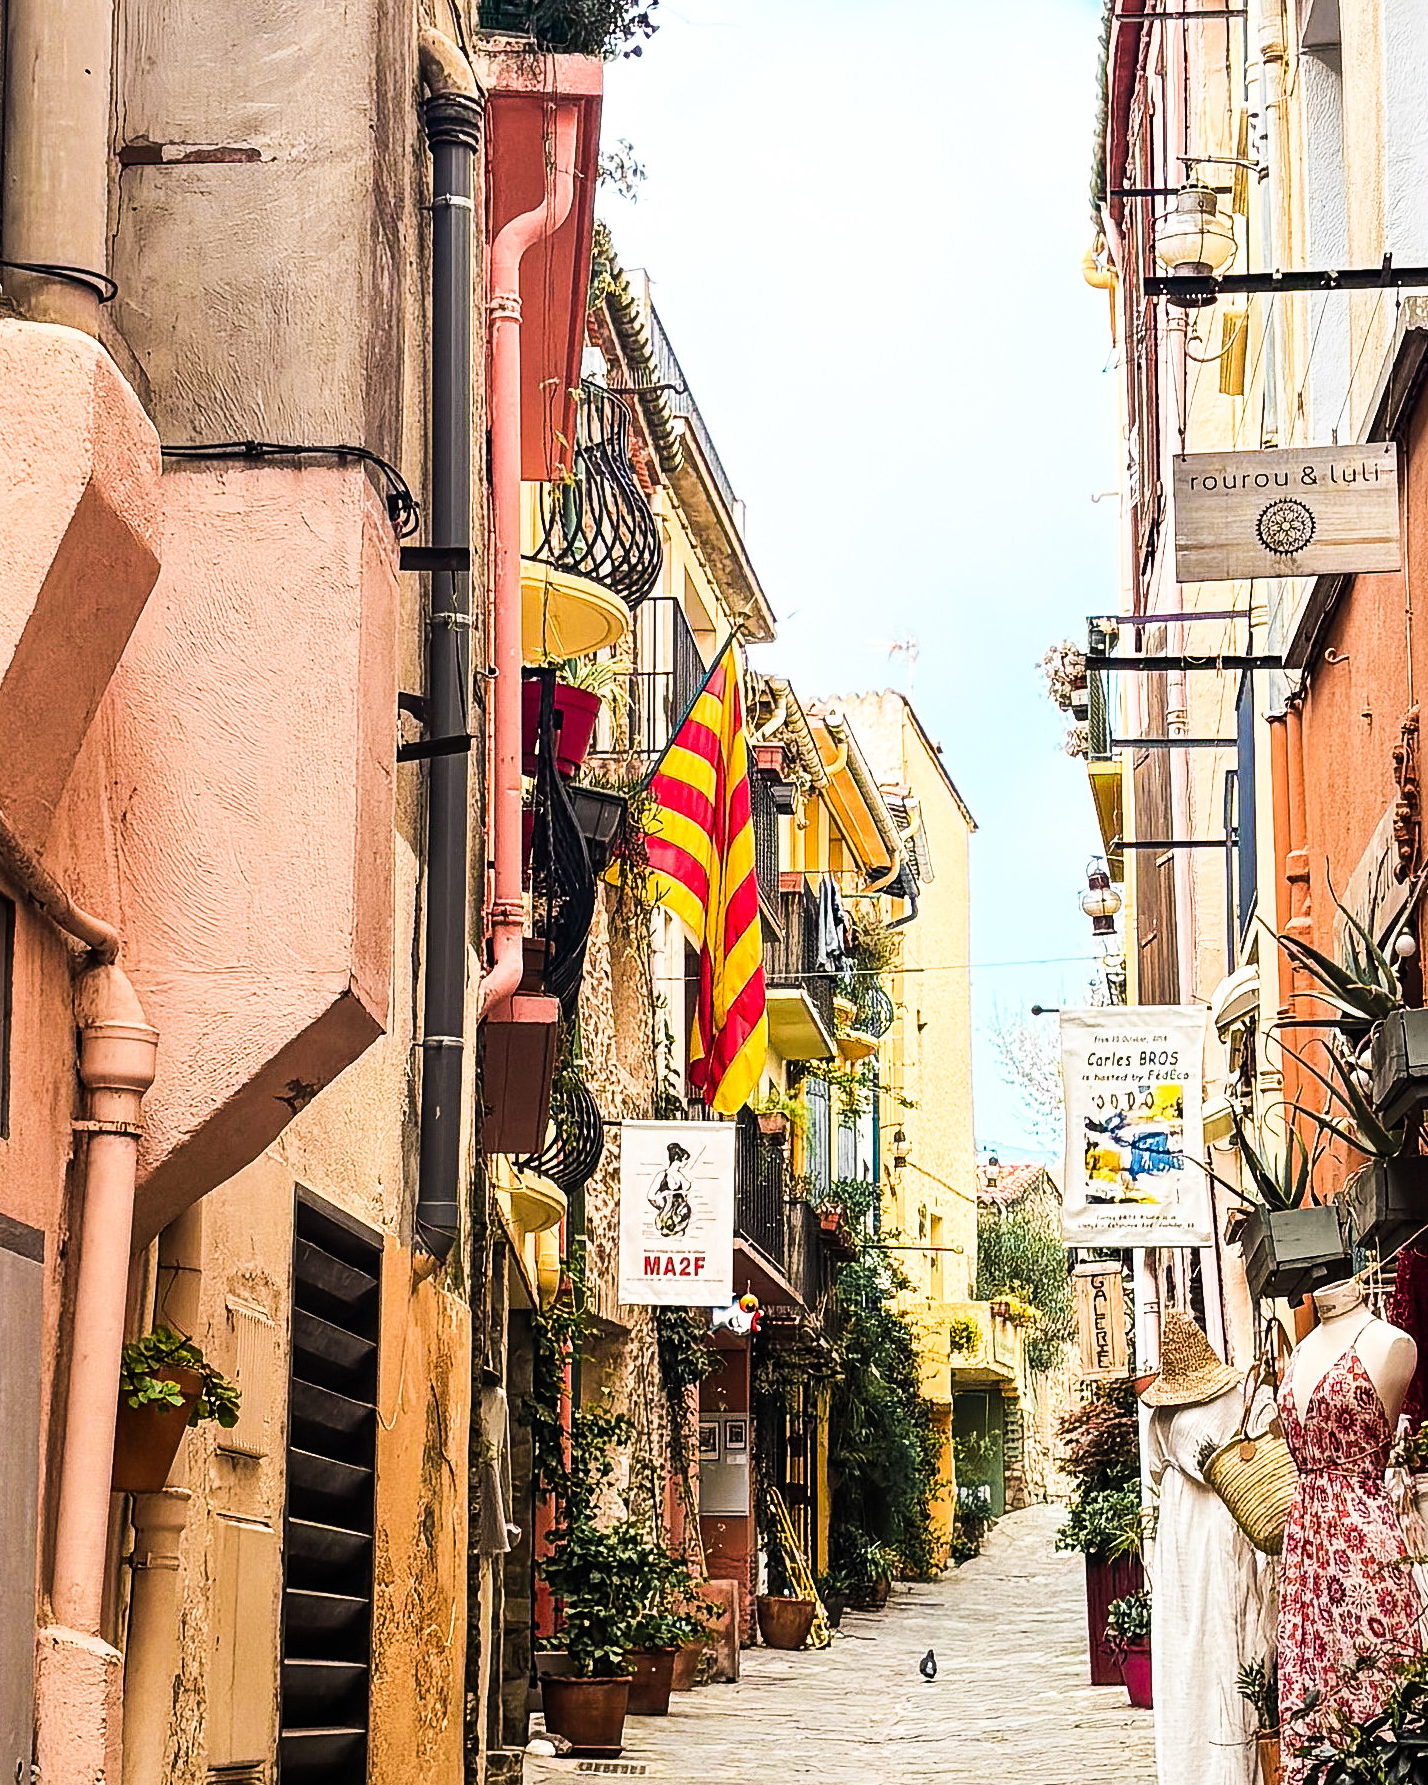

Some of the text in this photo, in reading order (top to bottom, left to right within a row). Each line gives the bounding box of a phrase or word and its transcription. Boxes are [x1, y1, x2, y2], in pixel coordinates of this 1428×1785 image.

[1190, 462, 1380, 491] rourou & luli
[1087, 1050, 1179, 1067] Carles BROS
[1082, 1073, 1090, 1081] is
[1094, 1072, 1128, 1082] hosted
[1132, 1073, 1144, 1083] by
[643, 1255, 706, 1277] MA2F
[1091, 1275, 1110, 1369] GALERIE
